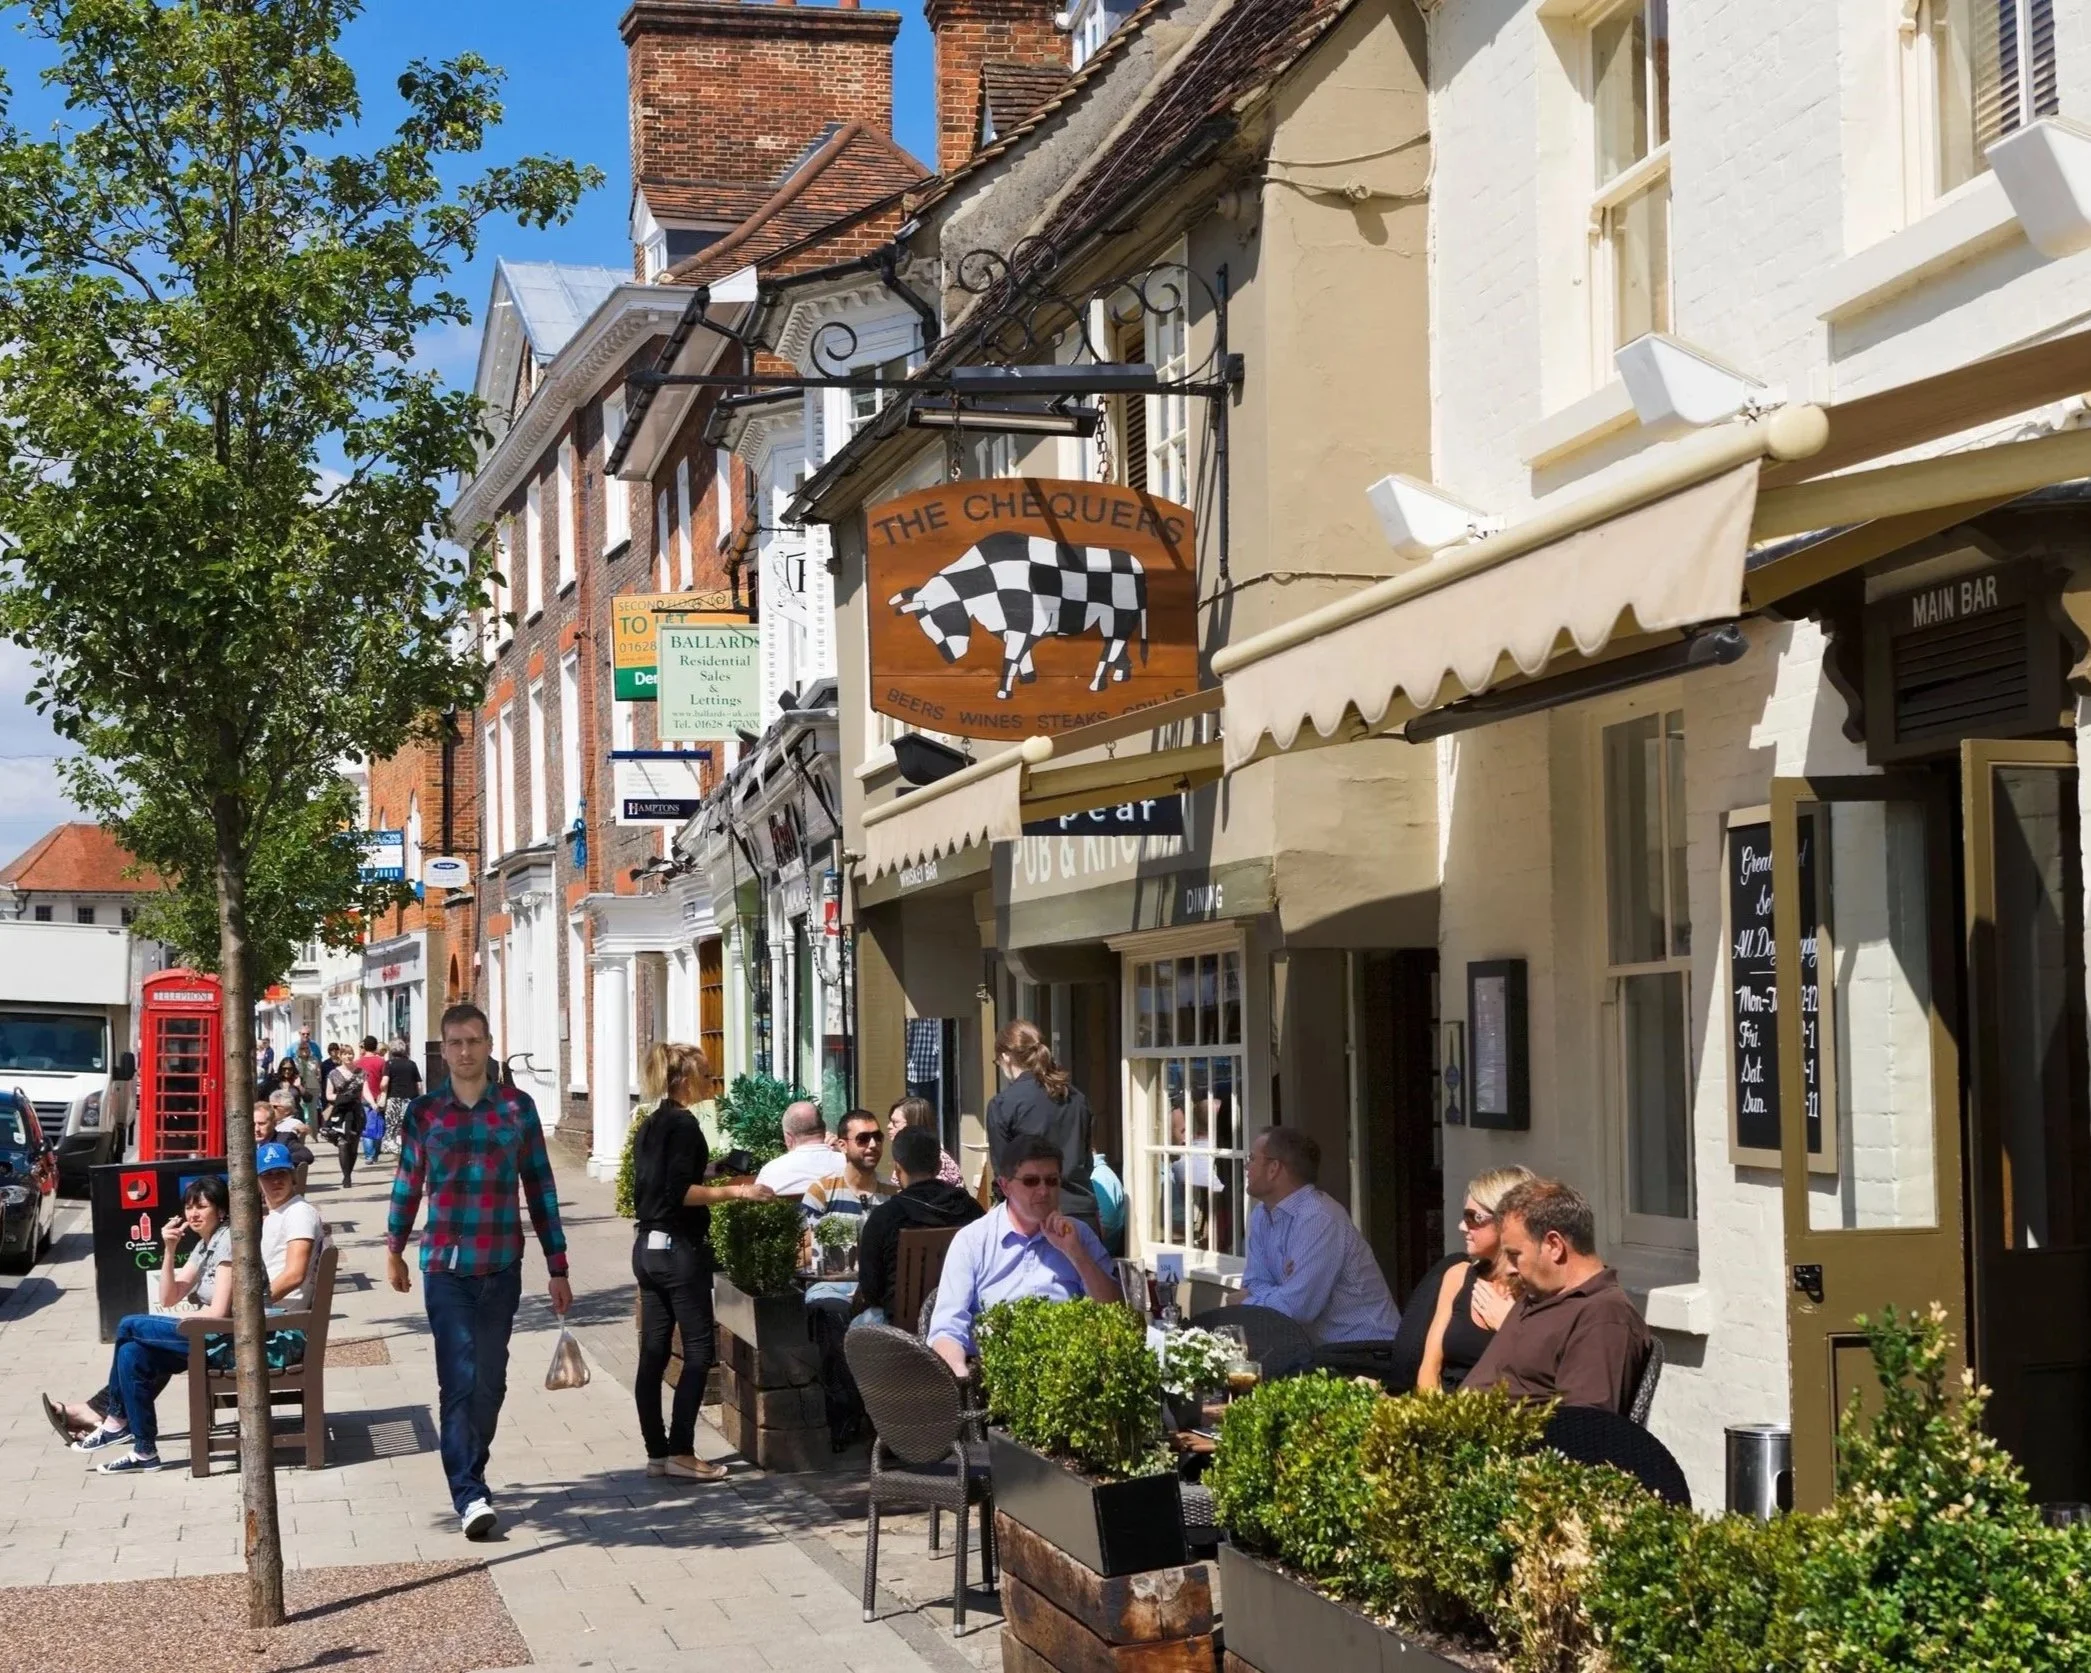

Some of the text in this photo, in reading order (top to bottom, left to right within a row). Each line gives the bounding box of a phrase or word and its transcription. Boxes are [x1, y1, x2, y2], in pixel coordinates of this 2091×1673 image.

[872, 492, 1186, 546] THE CHEQUERS
[1912, 575, 1998, 628] MAIN BAR
[618, 616, 648, 635] TO
[620, 641, 657, 653] 01628
[680, 655, 751, 666] Residential
[700, 670, 731, 681] Sales
[690, 694, 742, 706] Lettings
[709, 684, 718, 693] &
[887, 688, 945, 720] BEERS
[959, 711, 1023, 728] WINES
[628, 802, 680, 815] HAMPTONS
[1186, 884, 1223, 914] DINING
[1732, 930, 1755, 960] All
[156, 991, 210, 1001] TELEPHONE
[1739, 1020, 1761, 1049] Fri.
[1740, 1053, 1764, 1084] Sat.
[1742, 1086, 1768, 1115] Sun.
